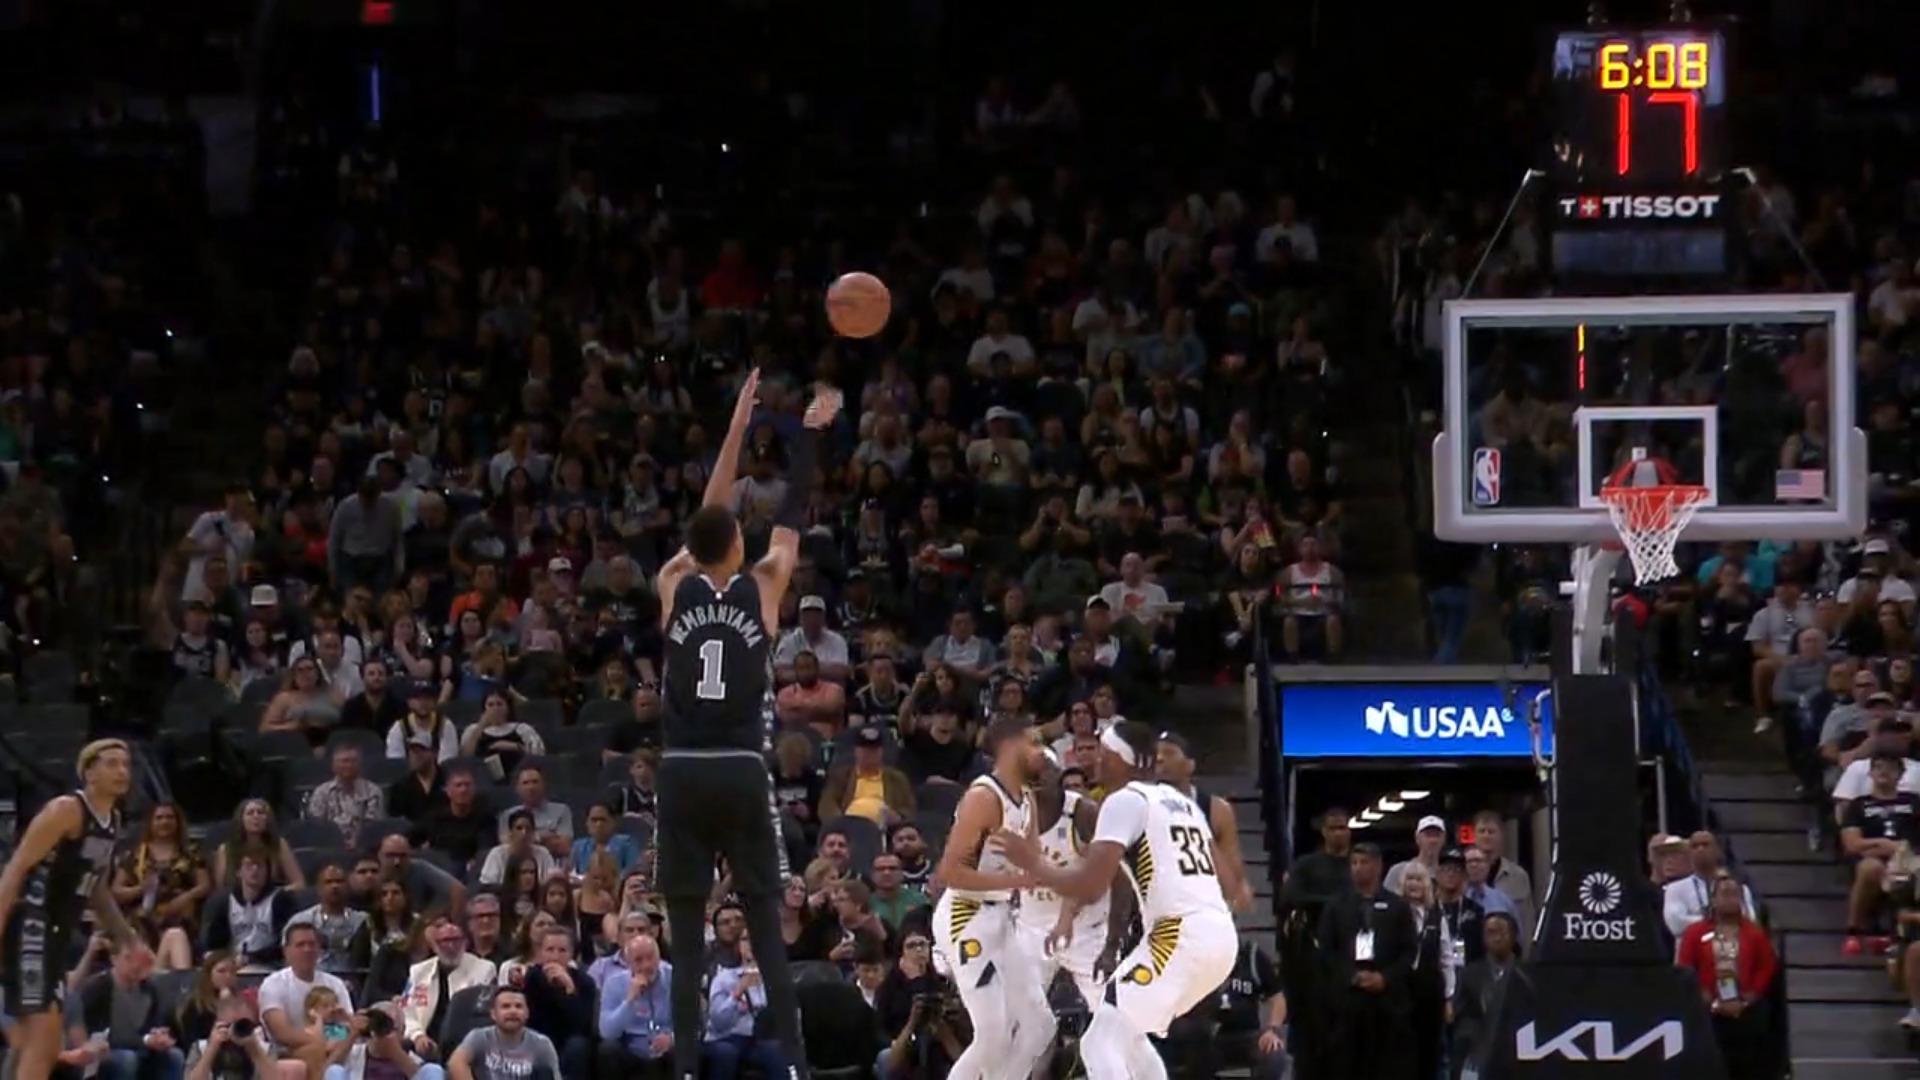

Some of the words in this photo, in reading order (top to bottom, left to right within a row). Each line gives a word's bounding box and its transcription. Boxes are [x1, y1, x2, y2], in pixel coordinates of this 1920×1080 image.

[1601, 43, 1708, 89] 6:08
[1618, 92, 1697, 175] 17
[1602, 195, 1720, 218] TISSOT
[696, 639, 726, 700] 1
[1170, 825, 1214, 876] 33
[1564, 913, 1636, 940] Frost
